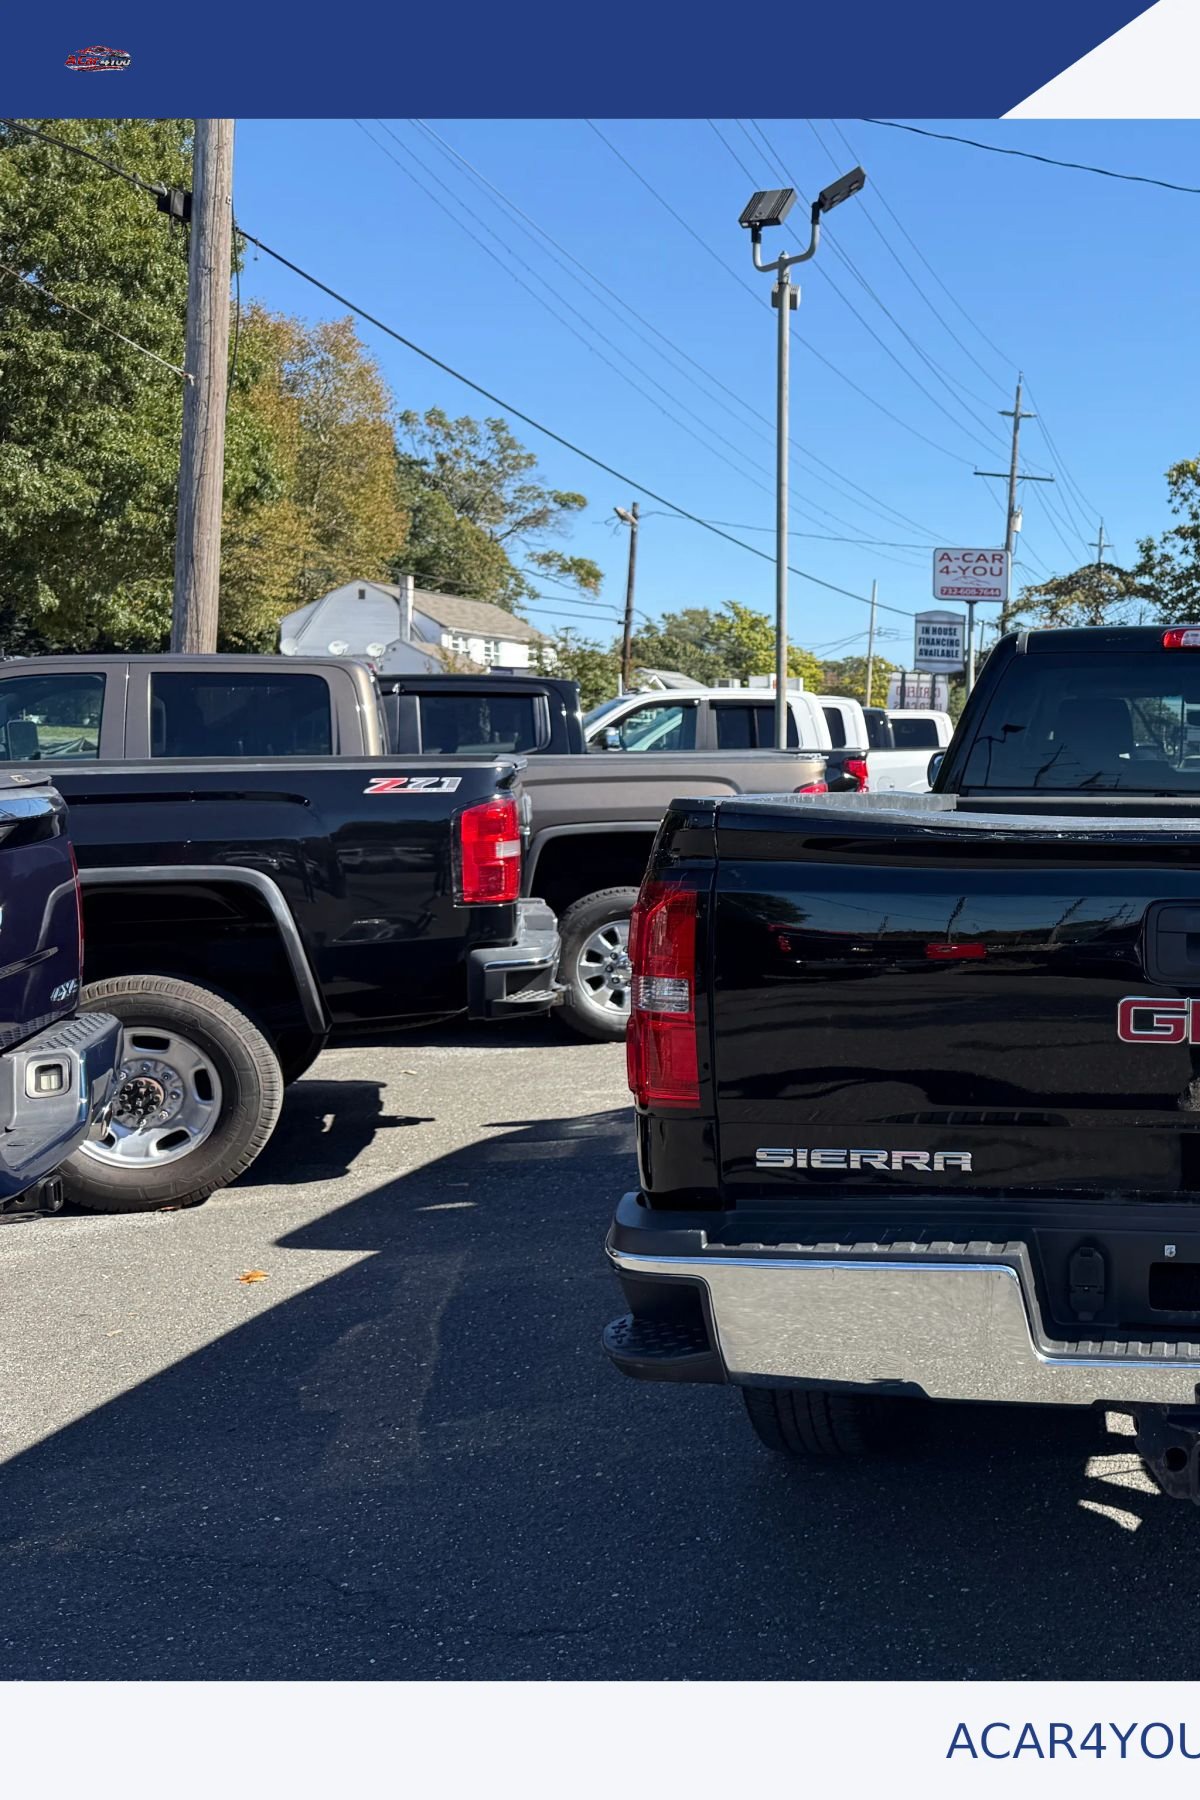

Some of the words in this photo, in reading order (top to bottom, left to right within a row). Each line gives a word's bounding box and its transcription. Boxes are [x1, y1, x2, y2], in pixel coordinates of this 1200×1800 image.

[938, 551, 1004, 564] A-CAR
[939, 565, 1003, 576] 4-YOU
[921, 626, 931, 635] IN
[932, 626, 958, 636] HOUSE
[918, 637, 960, 647] FINANCING
[918, 648, 960, 658] AVAILABLE
[363, 776, 462, 794] Z71
[755, 1147, 973, 1173] SIERRA
